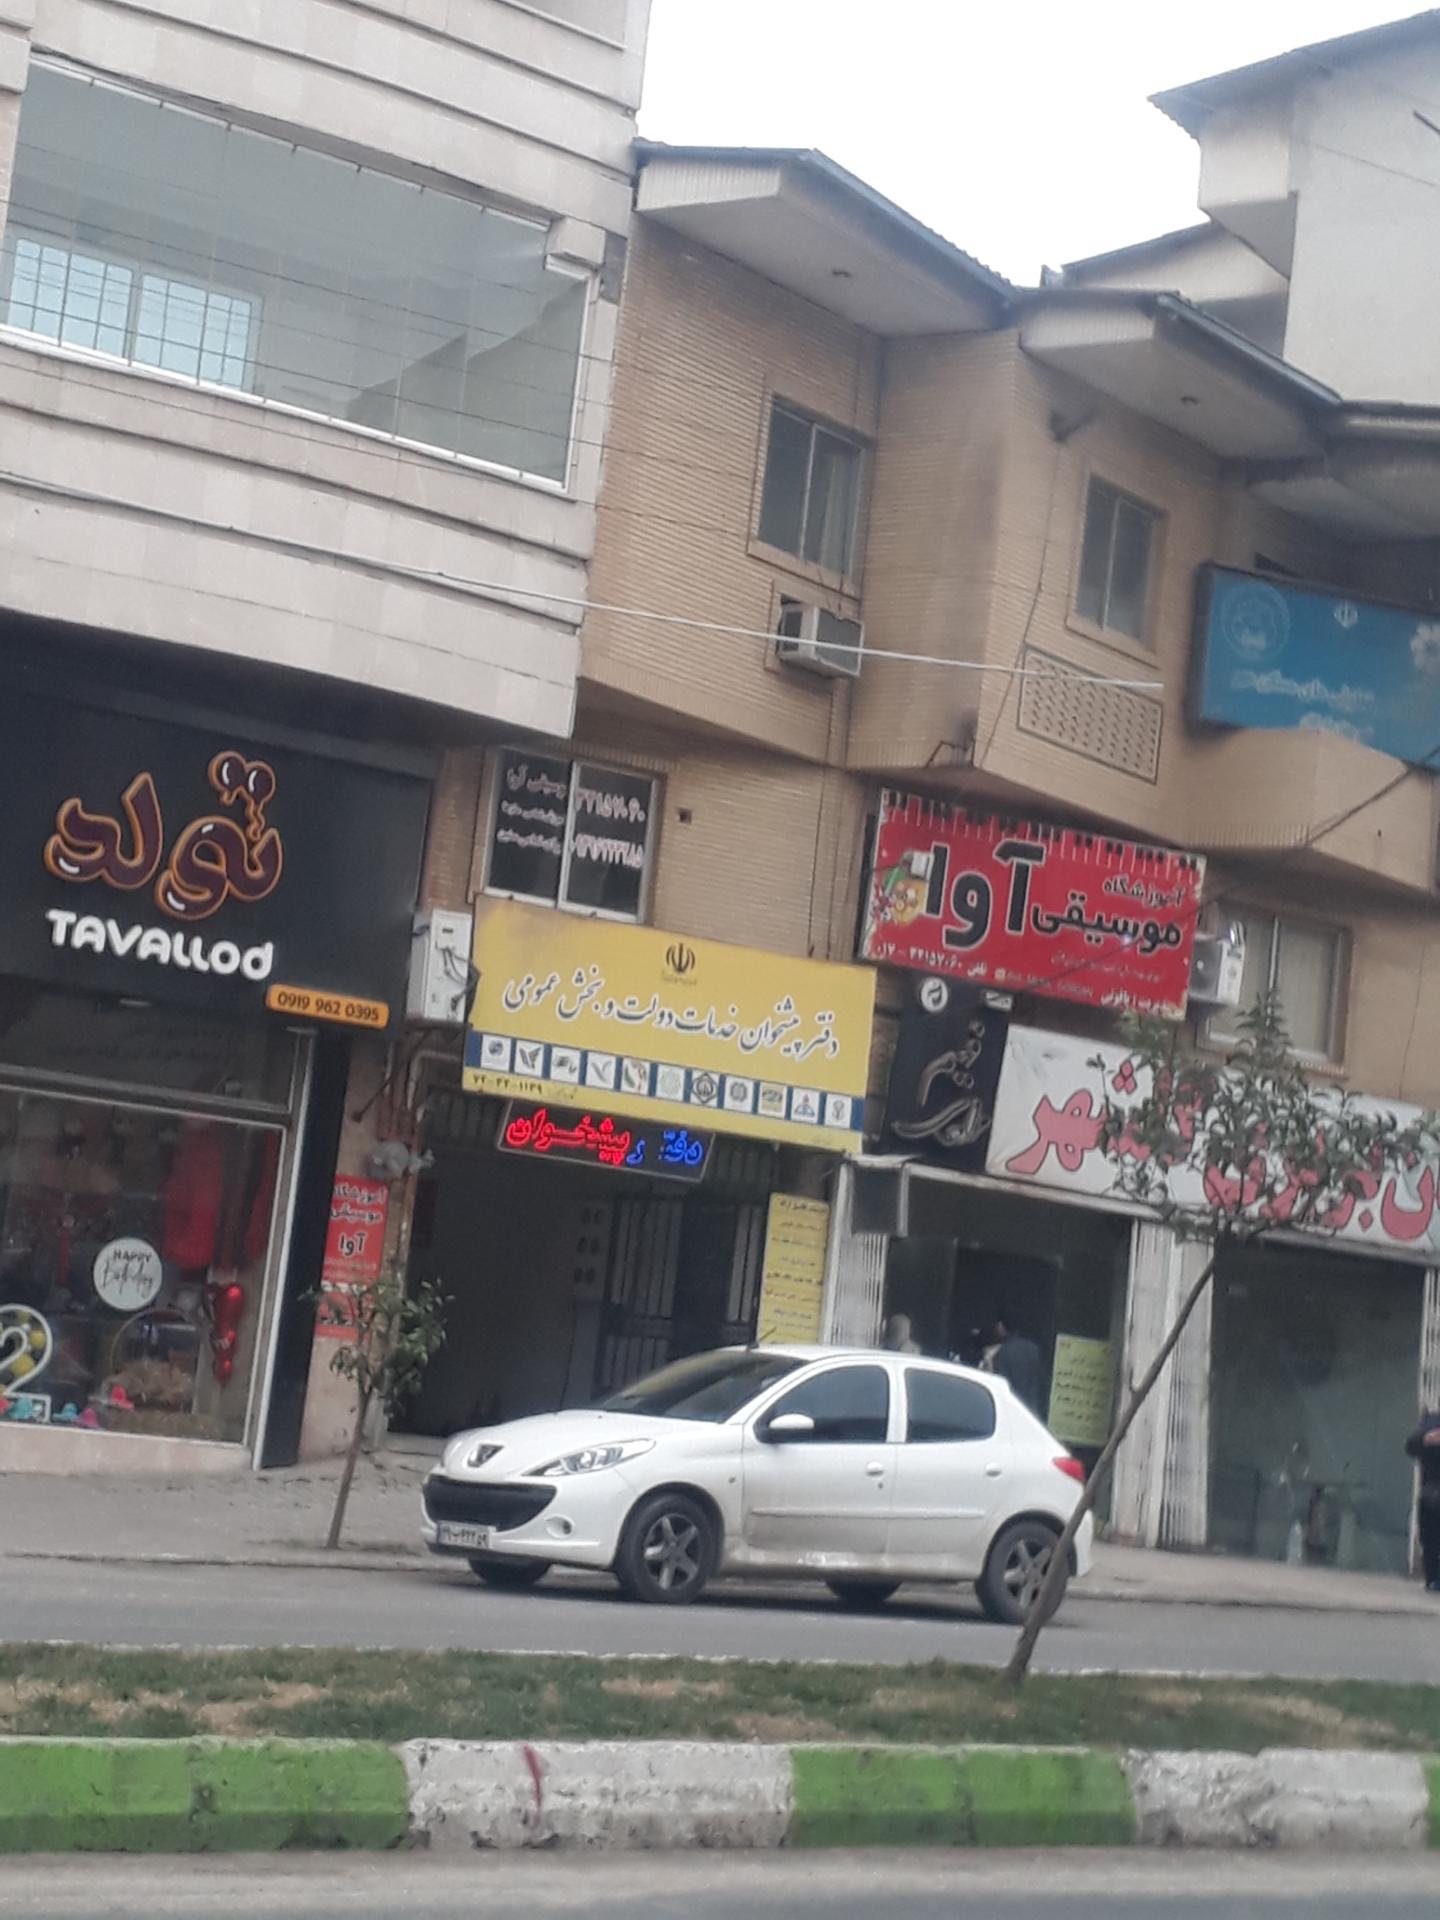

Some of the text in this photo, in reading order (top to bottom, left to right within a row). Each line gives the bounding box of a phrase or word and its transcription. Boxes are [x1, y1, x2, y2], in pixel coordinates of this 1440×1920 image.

[44, 750, 284, 920] تولد
[922, 838, 1182, 955] موسیقی آوا
[1104, 872, 1185, 908] آموزشگاه
[276, 991, 381, 1023] 0919 962 0395
[502, 963, 839, 1062] دفتر پیشخوان خدمات دولت و بخش عمومی
[505, 1108, 704, 1168] دفتر پیشخوان
[113, 1248, 153, 1264] HAPPY
[338, 1231, 367, 1257] آوا
